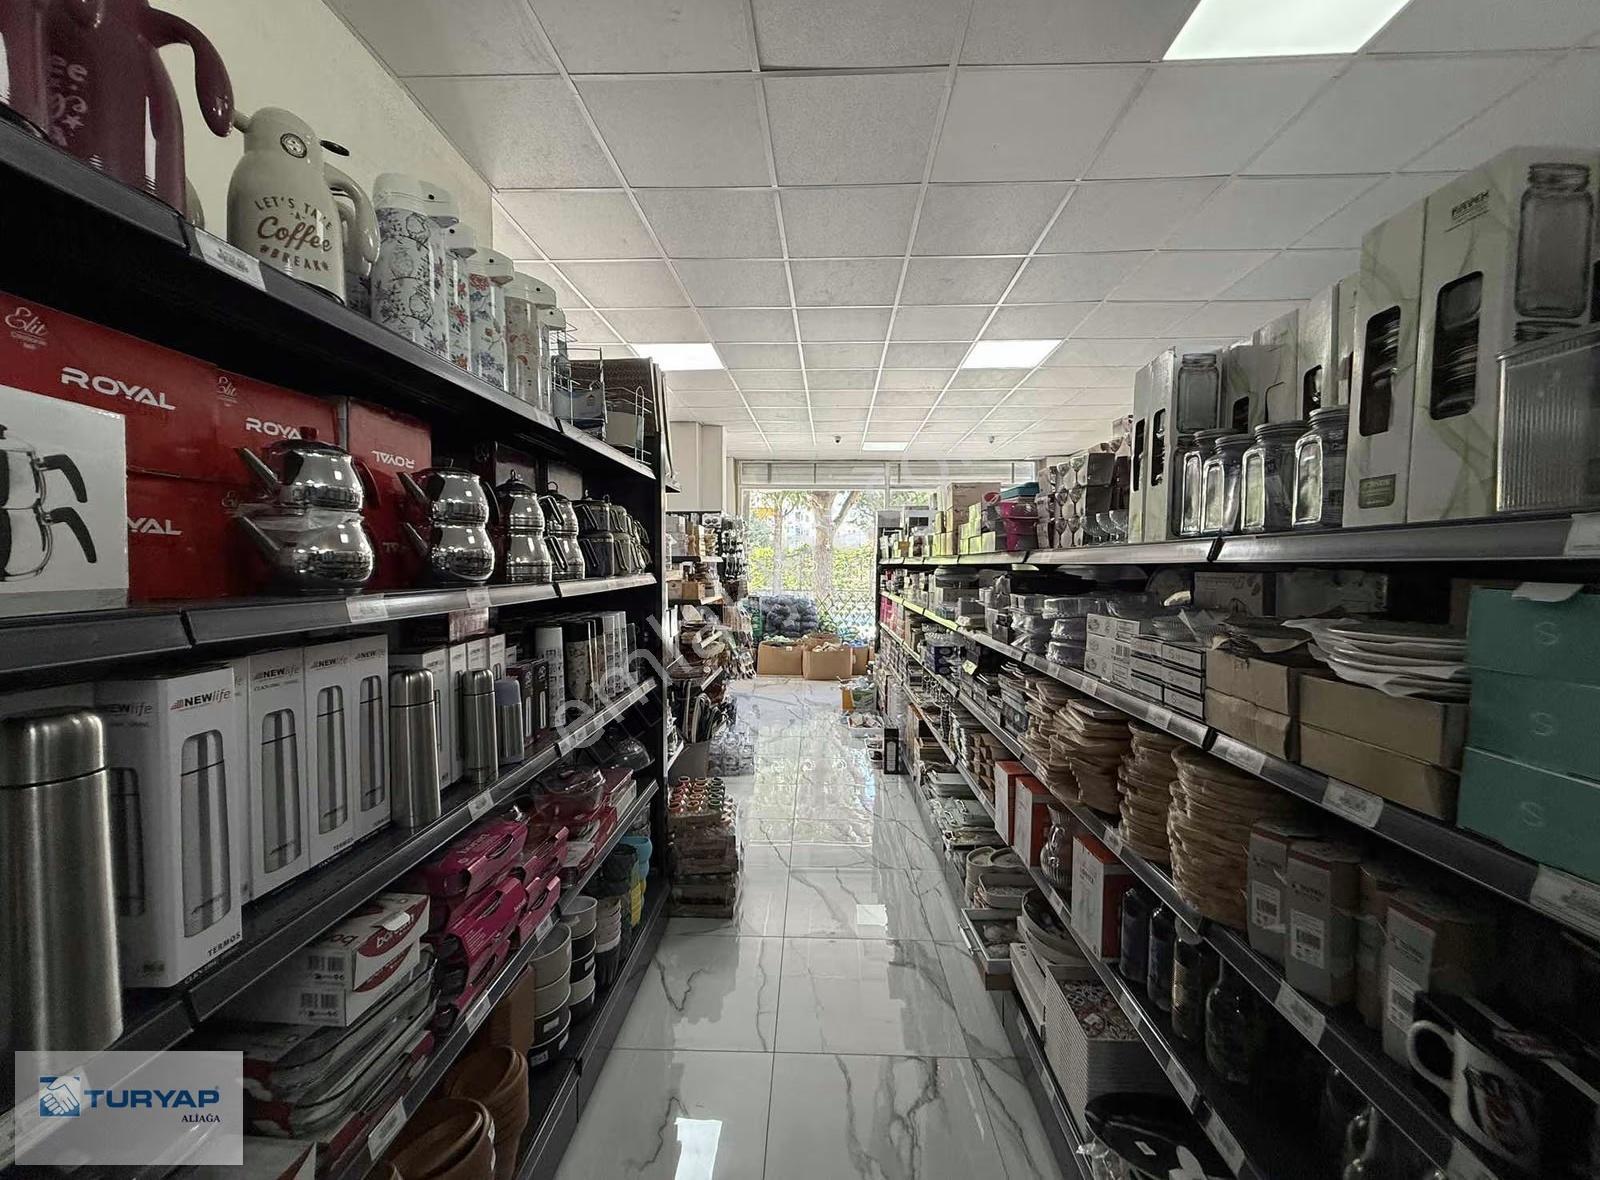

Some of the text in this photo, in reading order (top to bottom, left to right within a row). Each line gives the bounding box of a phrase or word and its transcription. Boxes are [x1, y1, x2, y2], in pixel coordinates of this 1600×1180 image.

[254, 196, 333, 230] LET'S TAE
[257, 215, 333, 252] Coffee
[60, 366, 177, 411] ROYAL
[245, 416, 303, 440] ROYA
[370, 449, 416, 469] ROYAL
[127, 516, 184, 536] YAL
[184, 688, 232, 707] NEWlife
[207, 931, 241, 957] TERMOS
